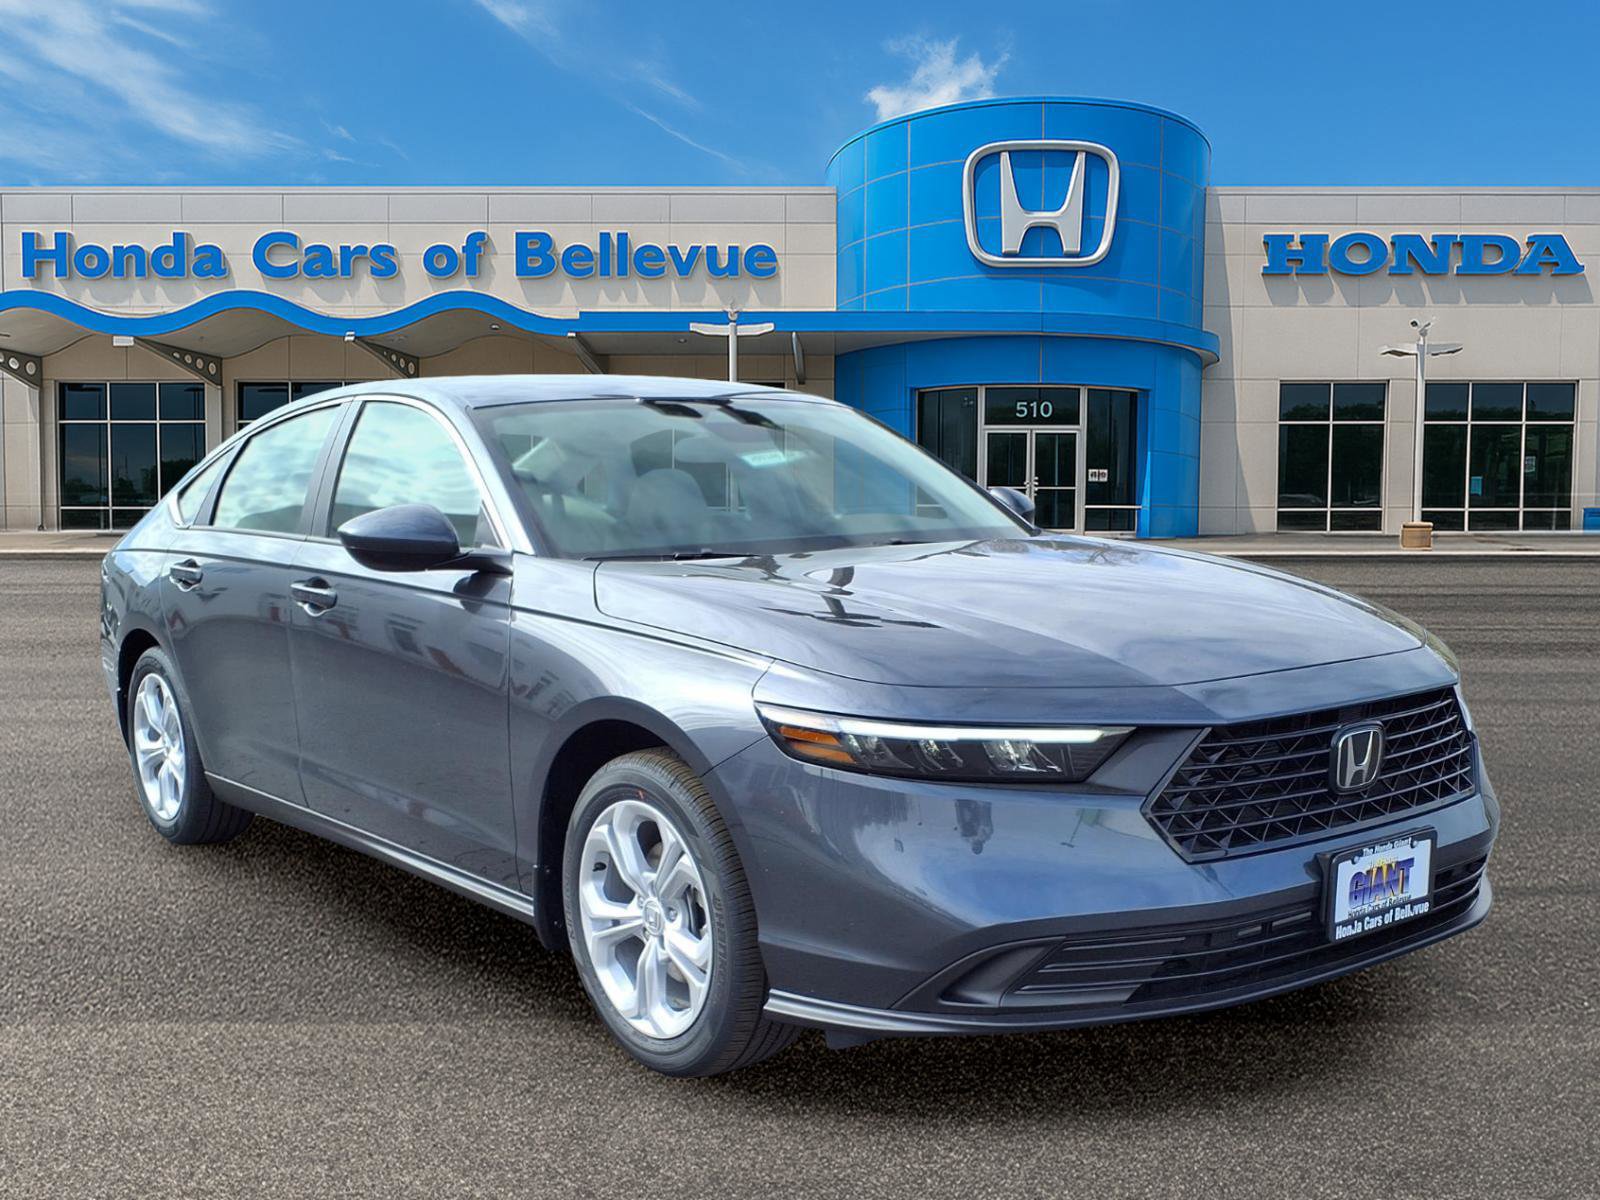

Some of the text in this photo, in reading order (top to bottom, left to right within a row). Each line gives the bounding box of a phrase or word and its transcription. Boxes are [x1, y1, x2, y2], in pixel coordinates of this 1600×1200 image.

[21, 231, 777, 279] Honda Cars of Bellevue
[1262, 232, 1585, 276] HONDA
[1015, 401, 1053, 418] 510
[1349, 857, 1415, 909] GIANT
[1364, 916, 1383, 930] Cars
[1384, 909, 1394, 924] of
